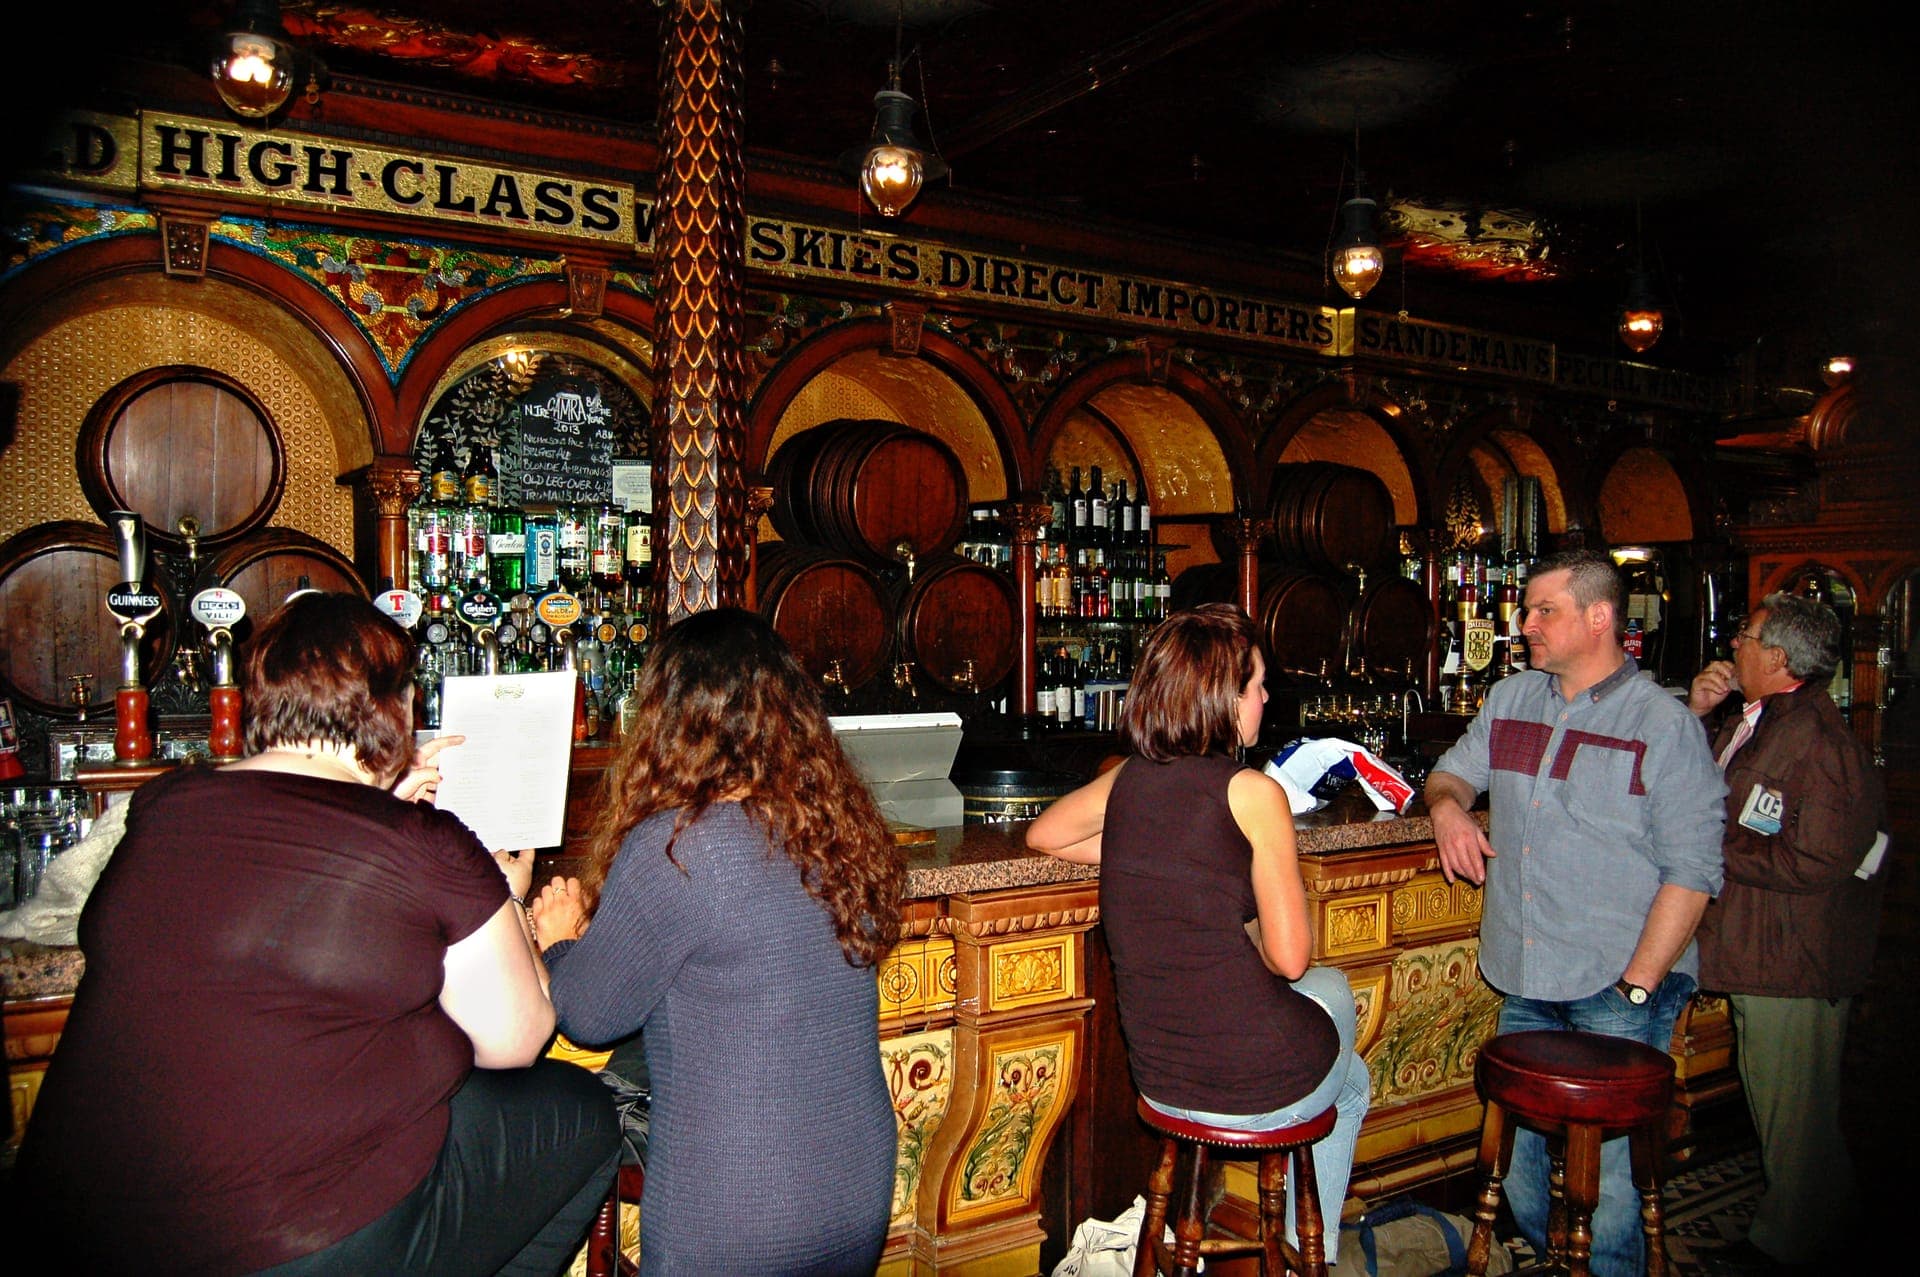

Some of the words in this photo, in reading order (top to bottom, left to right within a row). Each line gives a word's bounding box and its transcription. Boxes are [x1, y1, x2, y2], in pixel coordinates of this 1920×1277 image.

[939, 250, 1105, 310] DIRECT
[1117, 280, 1333, 345] IMPORTERS
[547, 394, 587, 422] CAMRA
[553, 423, 581, 435] 2013
[523, 459, 561, 471] BLONDE
[523, 473, 545, 487] OLD
[545, 475, 567, 489] LEG
[567, 477, 592, 490] OVER
[109, 593, 160, 608] GUINNESS
[463, 602, 497, 617] Carlsberg
[1468, 630, 1491, 642] OLD
[1467, 650, 1490, 660] OVER
